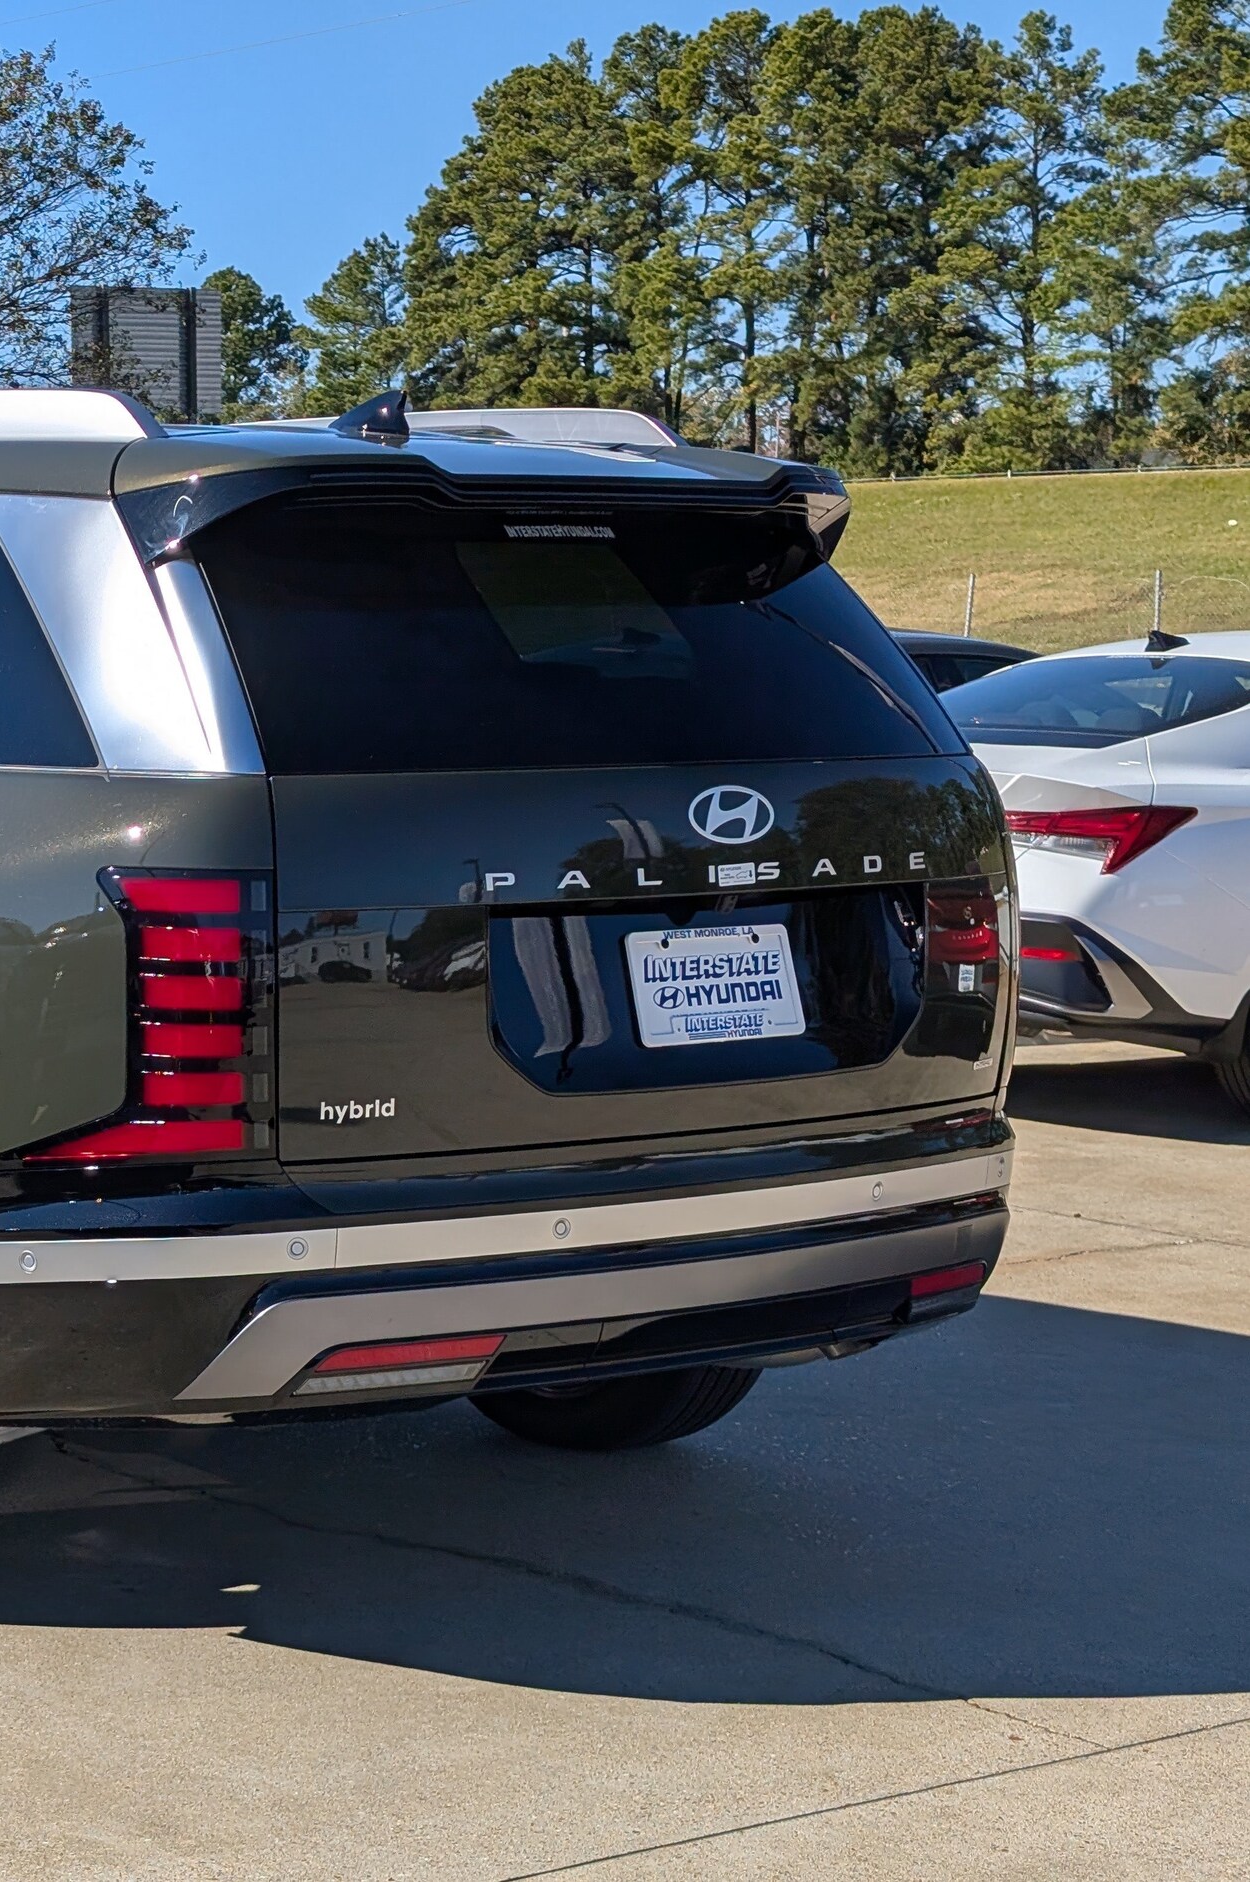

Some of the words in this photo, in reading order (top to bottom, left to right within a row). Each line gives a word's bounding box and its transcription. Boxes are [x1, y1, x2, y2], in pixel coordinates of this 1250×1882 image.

[485, 851, 926, 891] PALISADE
[663, 930, 691, 940] WEST
[694, 927, 740, 938] MONROE,
[742, 926, 754, 936] LA
[643, 950, 781, 983] INTERSTATE
[685, 980, 783, 1006] HYUNDAI
[685, 1012, 764, 1033] INTERSTATE
[727, 1028, 763, 1038] HYUNDAI
[320, 1098, 395, 1124] hybrid
